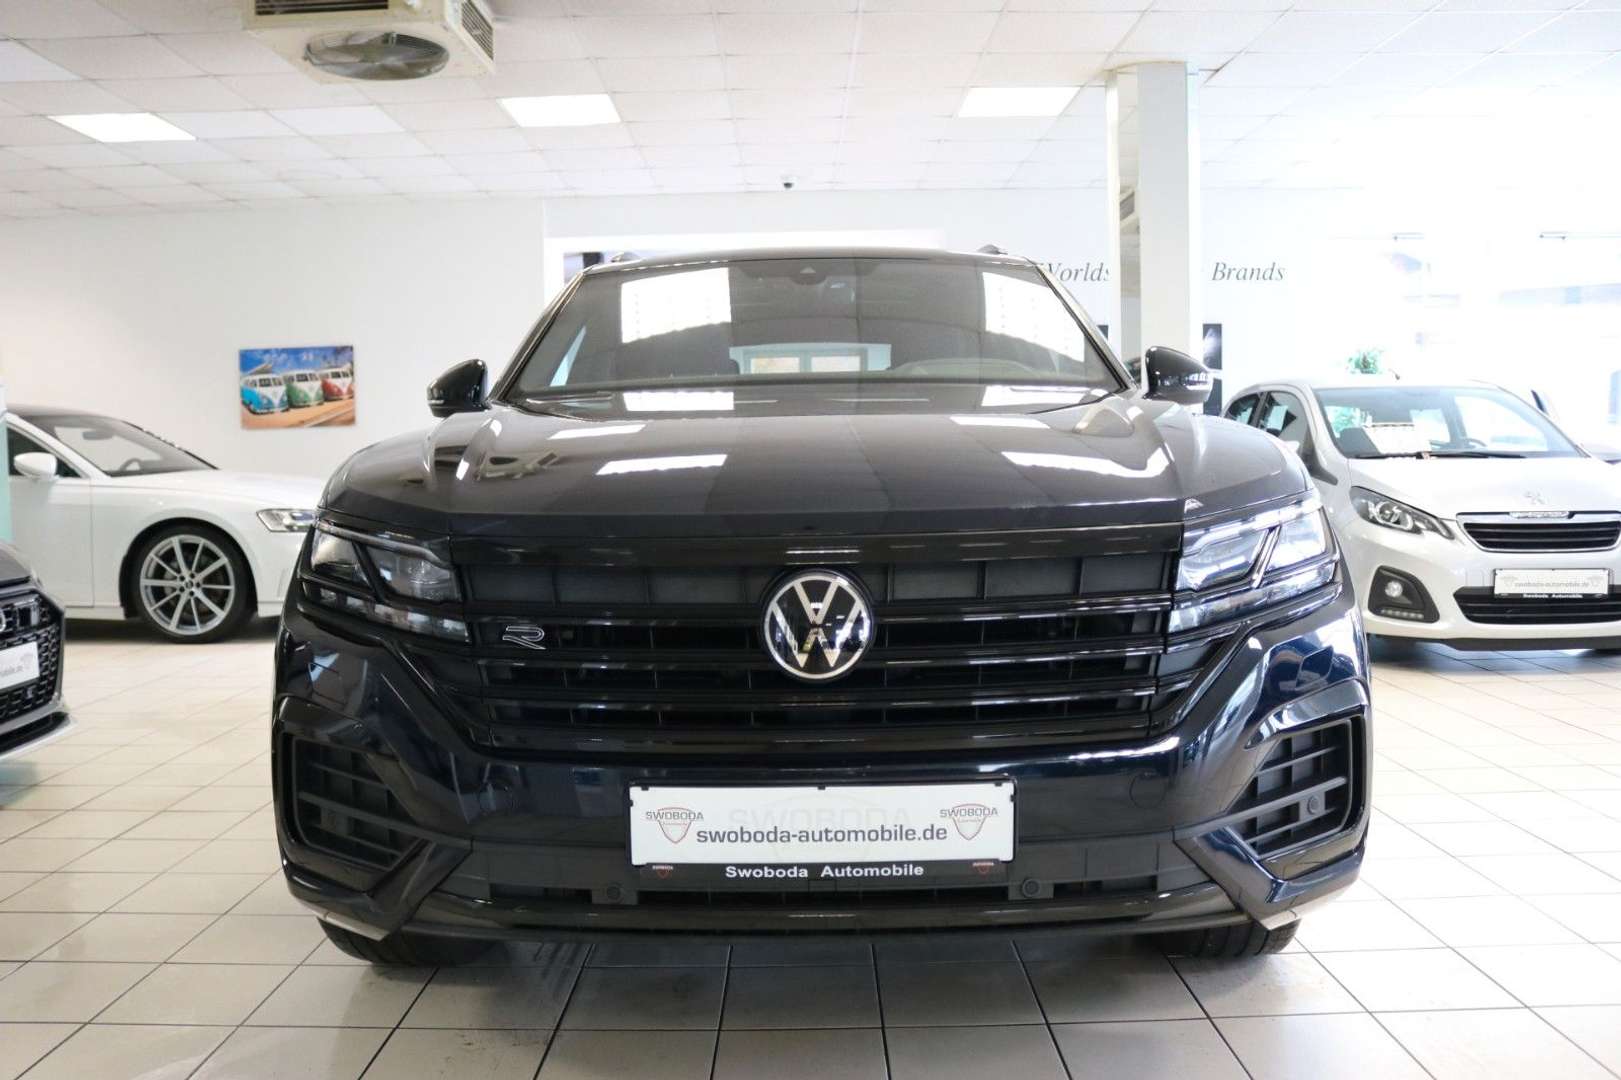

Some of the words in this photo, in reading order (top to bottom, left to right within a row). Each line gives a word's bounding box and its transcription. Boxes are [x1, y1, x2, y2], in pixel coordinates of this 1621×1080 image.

[1211, 261, 1286, 281] Brands
[645, 811, 704, 821] SWOBODA
[940, 807, 998, 818] SWOBODA
[696, 823, 947, 843] swoboda-automobile.de
[725, 865, 808, 878] Swoboda
[821, 864, 924, 878] Automobile
